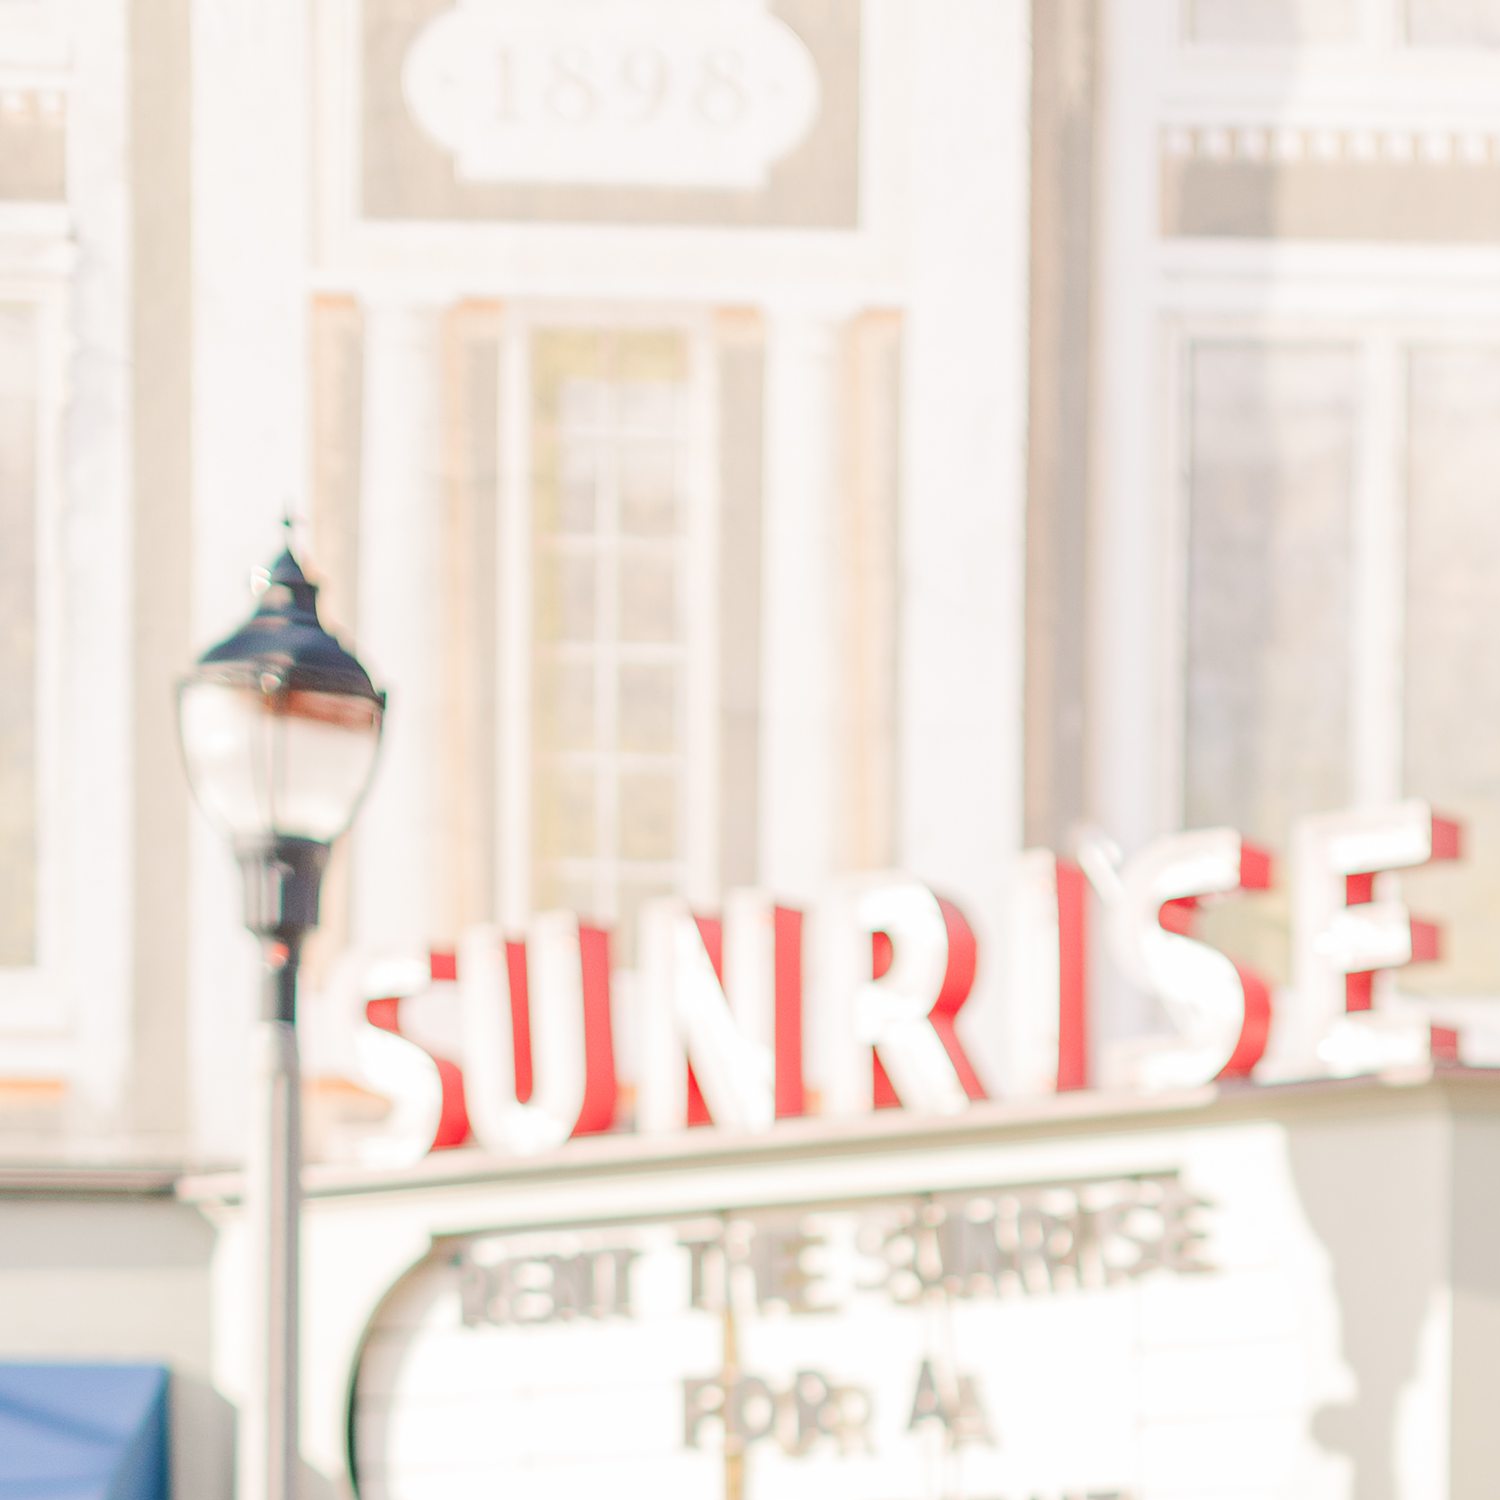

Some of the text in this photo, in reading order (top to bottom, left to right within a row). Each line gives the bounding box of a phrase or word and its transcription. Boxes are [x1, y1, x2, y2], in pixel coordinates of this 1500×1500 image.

[494, 44, 752, 128] 1898
[343, 803, 1462, 1169] SUNRISE
[460, 1190, 1222, 1328] RENT THE SUNRISE
[681, 1360, 985, 1452] FOR A
